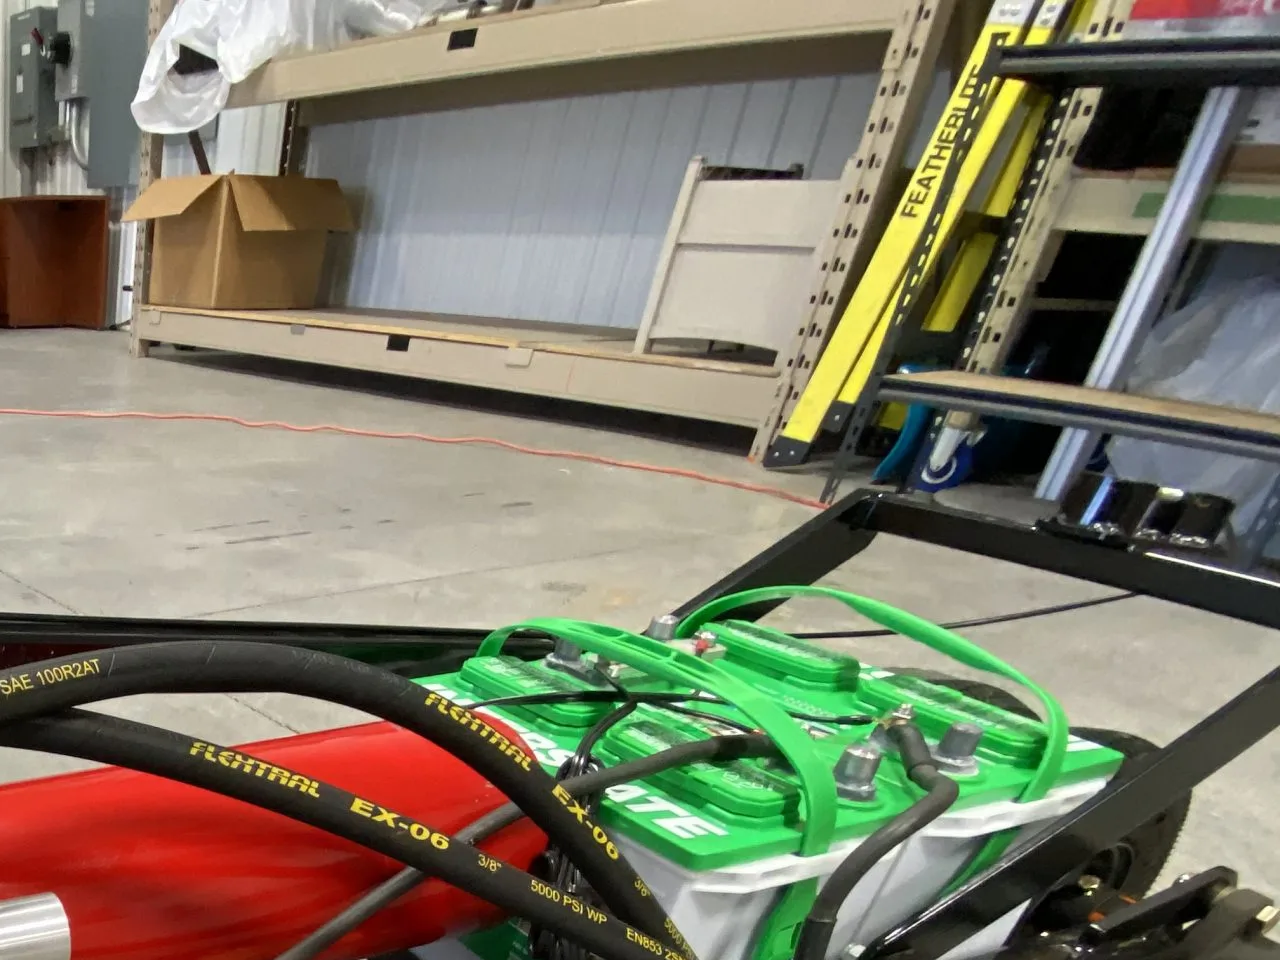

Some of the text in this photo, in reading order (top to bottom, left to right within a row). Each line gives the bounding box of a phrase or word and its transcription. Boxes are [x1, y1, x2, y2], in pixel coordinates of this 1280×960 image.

[36, 658, 101, 686] 100R2AT
[189, 741, 320, 799] FLEXTRAL
[349, 796, 450, 851] EX-06
[477, 853, 502, 873] 3/8"
[530, 879, 561, 903] 5000
[562, 894, 584, 915] PSI
[587, 906, 608, 925] WP
[625, 927, 663, 956] EN853
[424, 693, 532, 772] FLEXTRAL
[552, 783, 619, 860] EX-06
